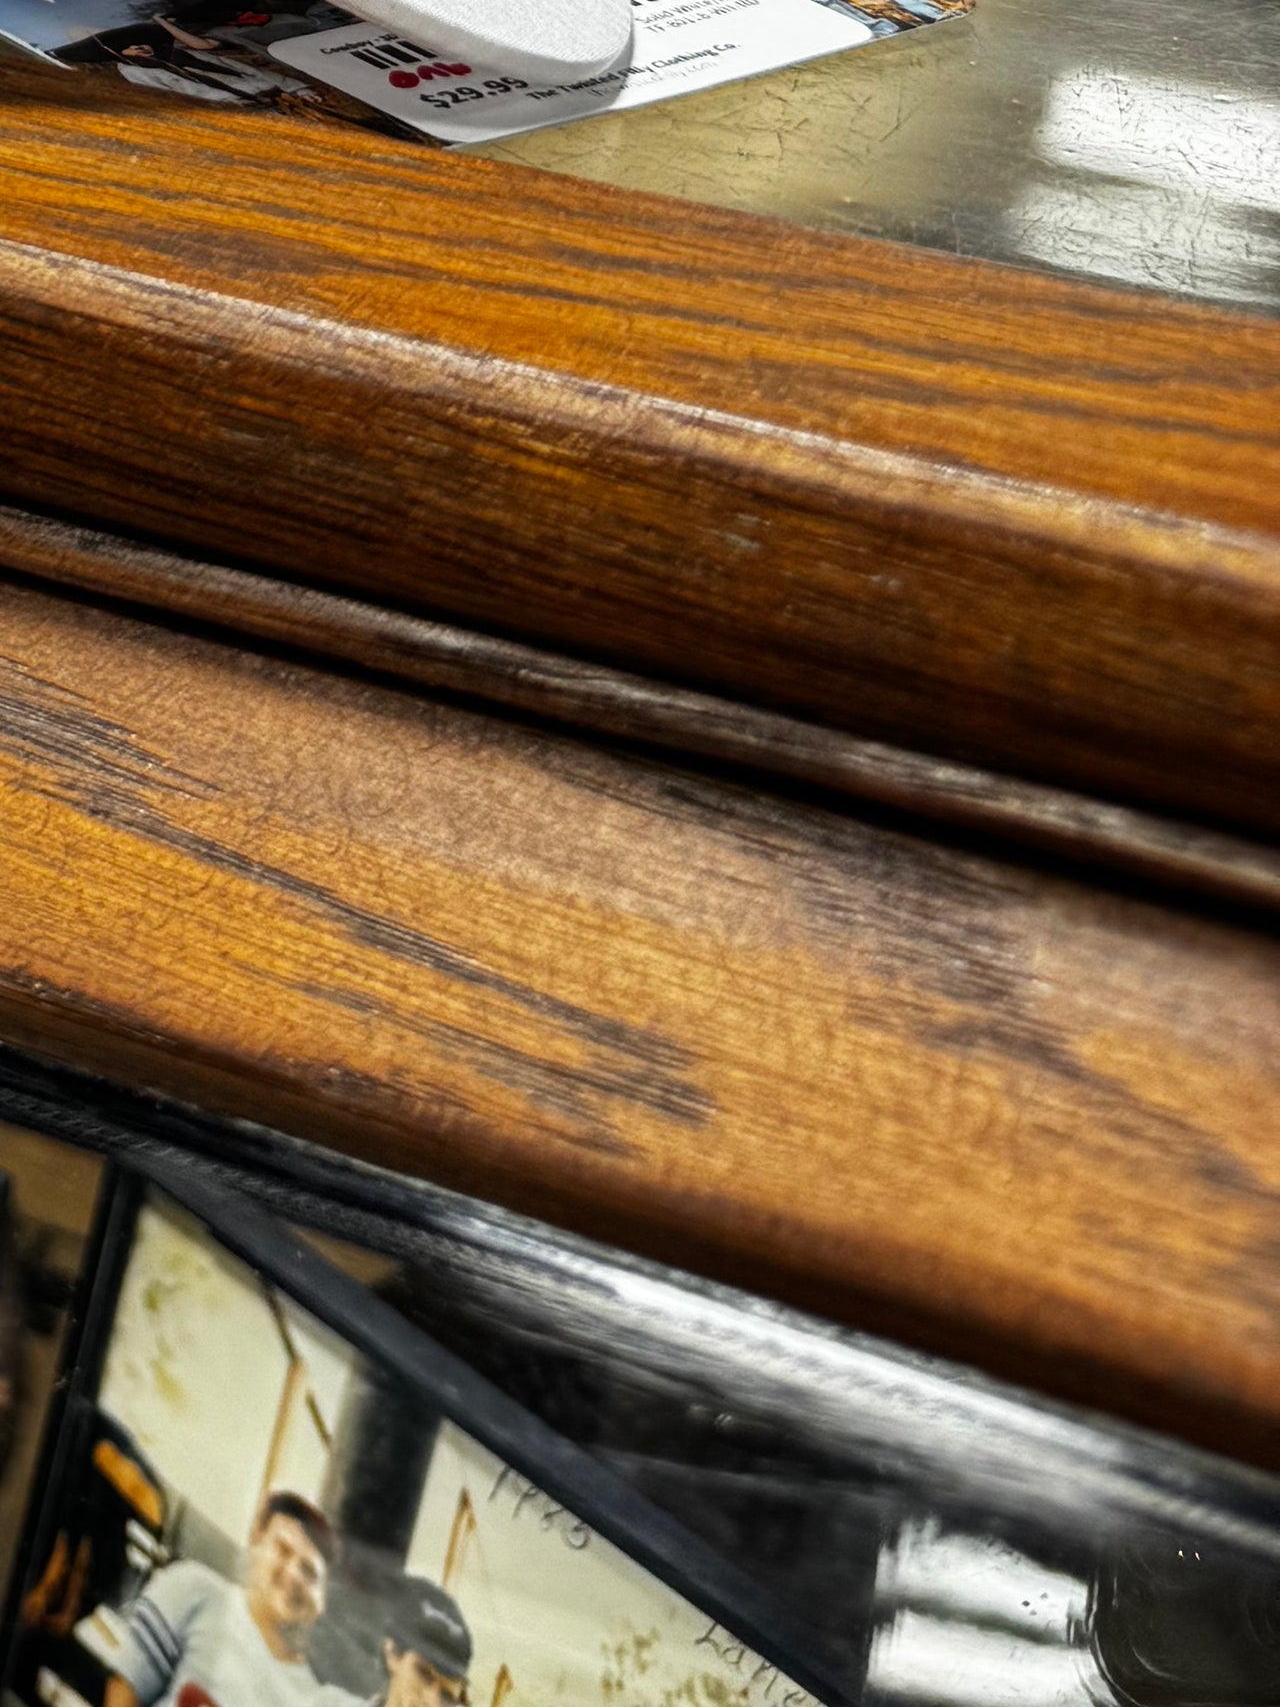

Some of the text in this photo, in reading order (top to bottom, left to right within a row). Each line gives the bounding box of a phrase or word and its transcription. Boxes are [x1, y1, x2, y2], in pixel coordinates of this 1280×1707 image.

[419, 75, 530, 109] $29.99
[525, 88, 556, 101] The
[554, 72, 621, 94] Twisted
[650, 46, 717, 70] Clothing
